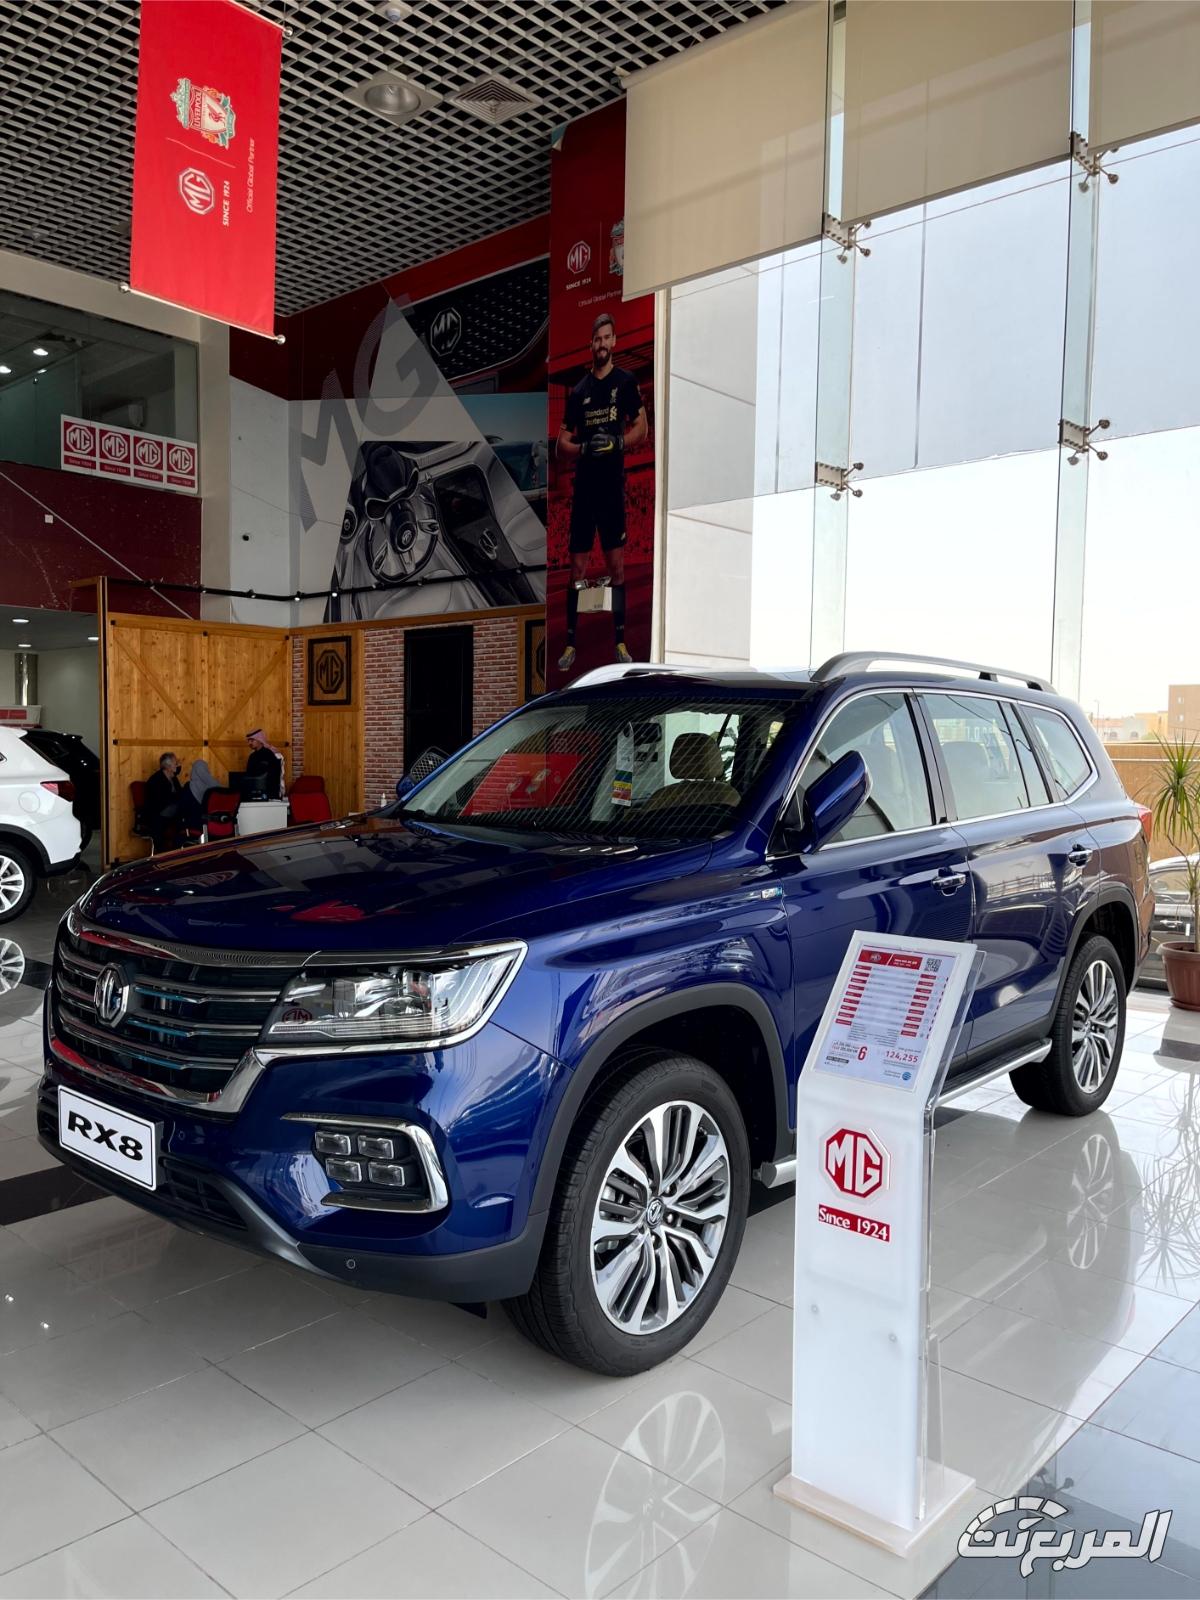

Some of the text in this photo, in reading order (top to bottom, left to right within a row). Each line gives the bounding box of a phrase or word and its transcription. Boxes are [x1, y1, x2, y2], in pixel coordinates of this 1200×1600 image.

[193, 90, 202, 127] LIVERPOOL
[182, 172, 212, 209] MG
[246, 137, 255, 213] Official Global Partner
[222, 180, 230, 227] SINCE 1924
[570, 245, 588, 269] MG
[69, 428, 91, 453] MG
[103, 435, 125, 459] MG
[138, 442, 159, 466] MG
[170, 448, 191, 473] MG
[319, 654, 341, 689] MG
[857, 1045, 868, 1061] 6
[885, 1050, 919, 1063] 124,255
[67, 1110, 144, 1162] RX8
[827, 1131, 881, 1196] MG
[818, 1206, 888, 1240] Since 1924
